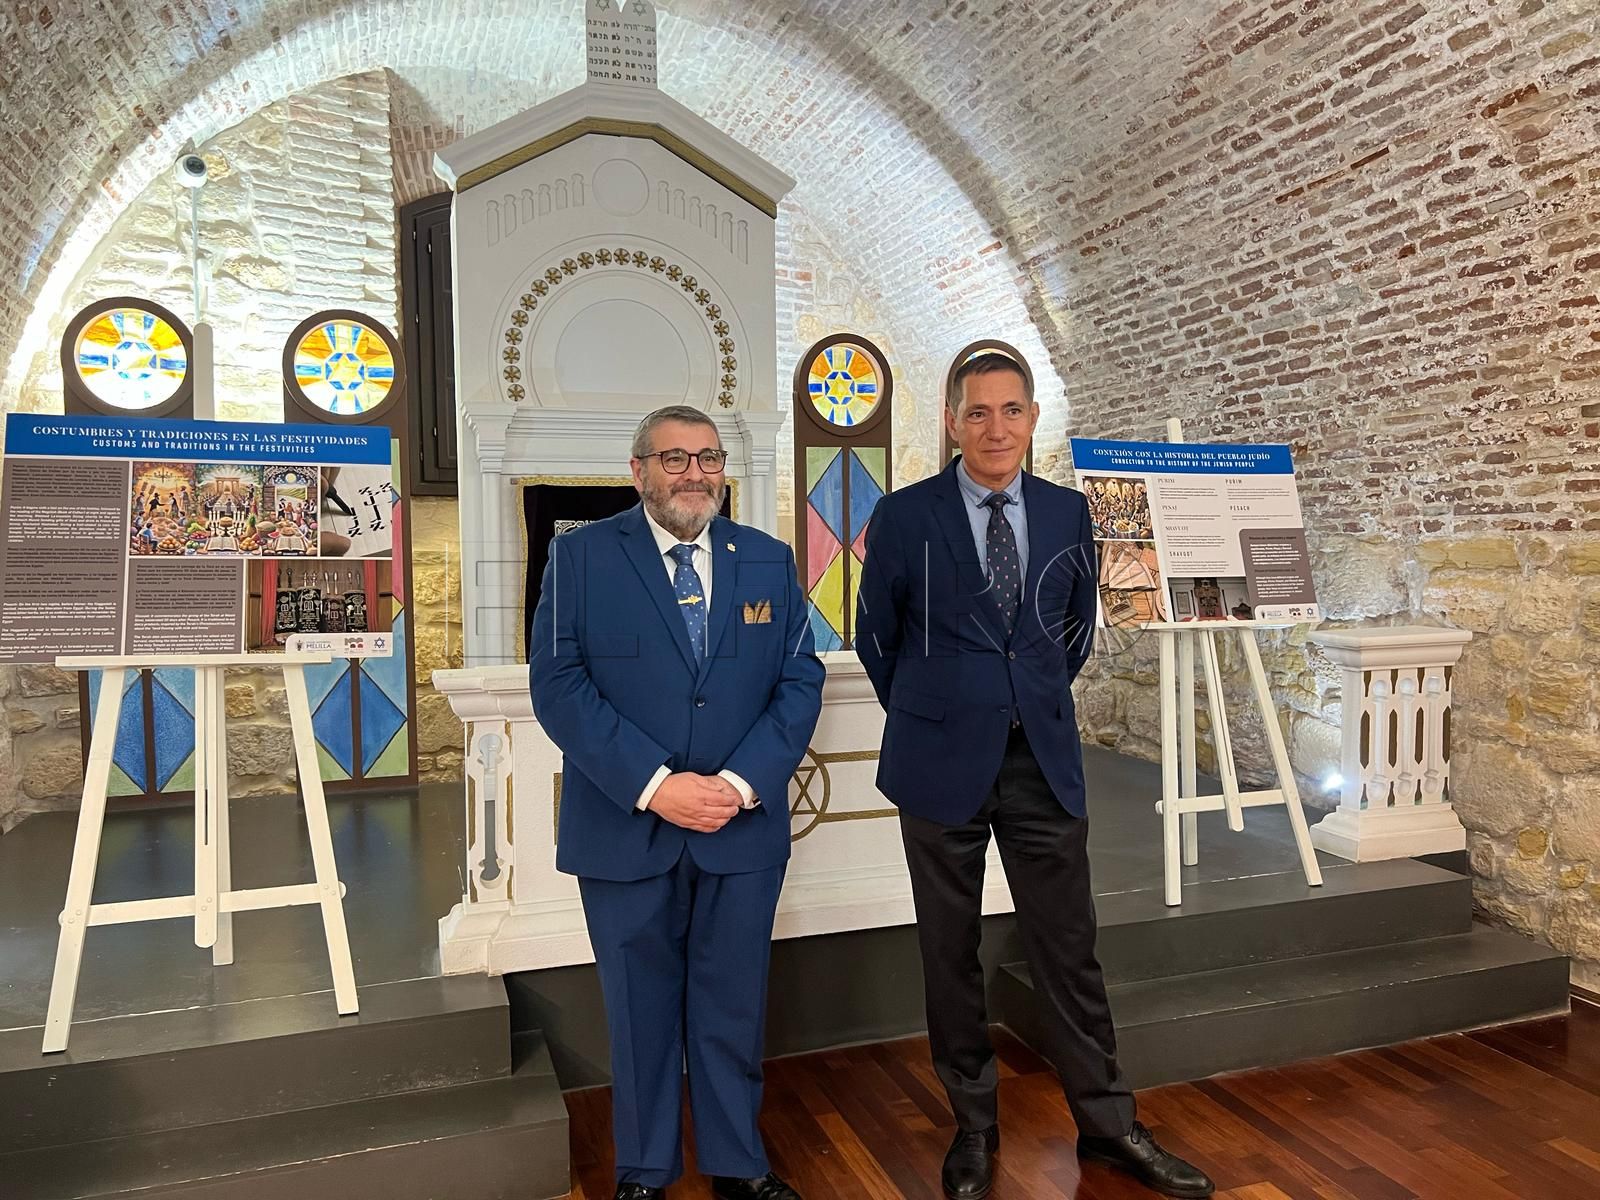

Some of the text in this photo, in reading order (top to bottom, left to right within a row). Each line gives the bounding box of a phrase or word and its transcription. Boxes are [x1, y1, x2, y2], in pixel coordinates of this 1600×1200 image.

[33, 426, 368, 446] COSTUMBRES Y TRADICIONES EN LAS FESTIVIDADES
[93, 440, 137, 448] CUSTOMS
[165, 442, 220, 450] TRADITIONS
[239, 444, 255, 452] THE
[260, 445, 315, 454] FESTIVITIES
[1094, 448, 1133, 456] CONEXIÓN
